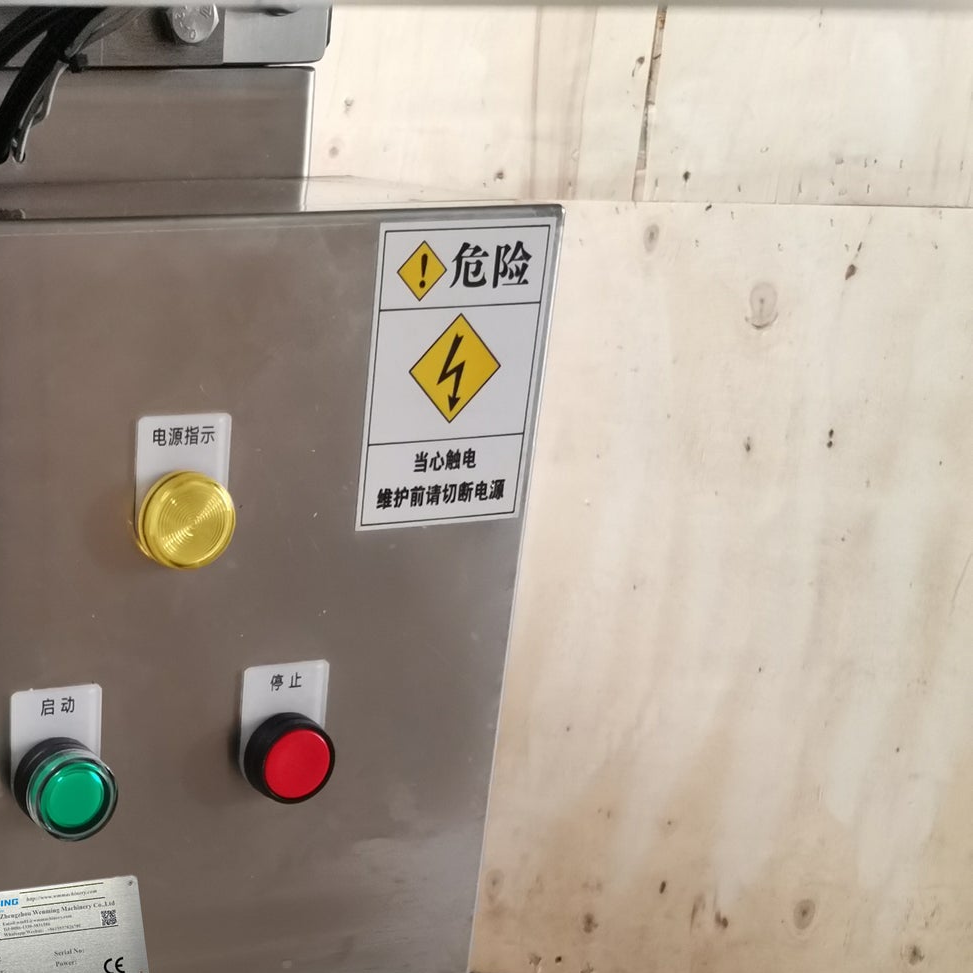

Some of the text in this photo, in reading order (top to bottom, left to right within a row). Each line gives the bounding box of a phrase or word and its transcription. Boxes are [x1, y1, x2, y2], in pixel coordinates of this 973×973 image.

[449, 241, 533, 288] 危险
[152, 425, 215, 447] 电源指示
[414, 448, 477, 473] 当心触电
[376, 479, 506, 510] 维护前请切断电源
[270, 672, 302, 692] 停止
[40, 696, 76, 717] 启动
[0, 909, 32, 920] Zhengzhou
[32, 906, 60, 917] Wenming
[61, 903, 93, 914] Machinery
[54, 947, 85, 957] Serial No:
[55, 960, 78, 968] Power:
